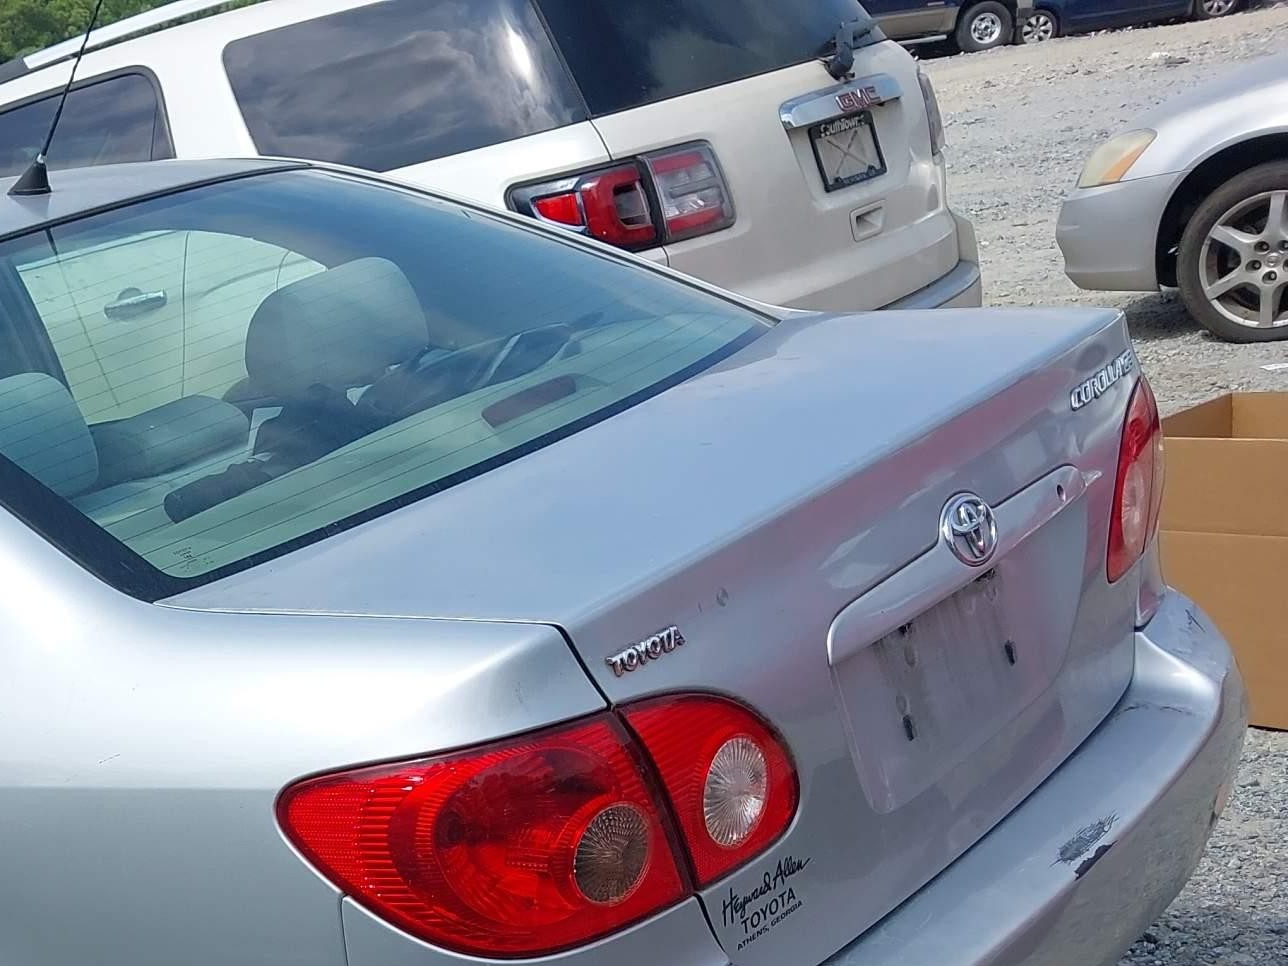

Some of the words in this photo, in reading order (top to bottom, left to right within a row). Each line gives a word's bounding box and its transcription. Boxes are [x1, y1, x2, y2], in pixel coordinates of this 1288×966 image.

[835, 86, 880, 112] GMC
[1070, 357, 1123, 411] COROLLA
[606, 625, 685, 677] TOYOTA
[737, 924, 770, 951] ATHENS,
[770, 900, 803, 927] GEORGIA
[740, 887, 796, 934] TOYOTA
